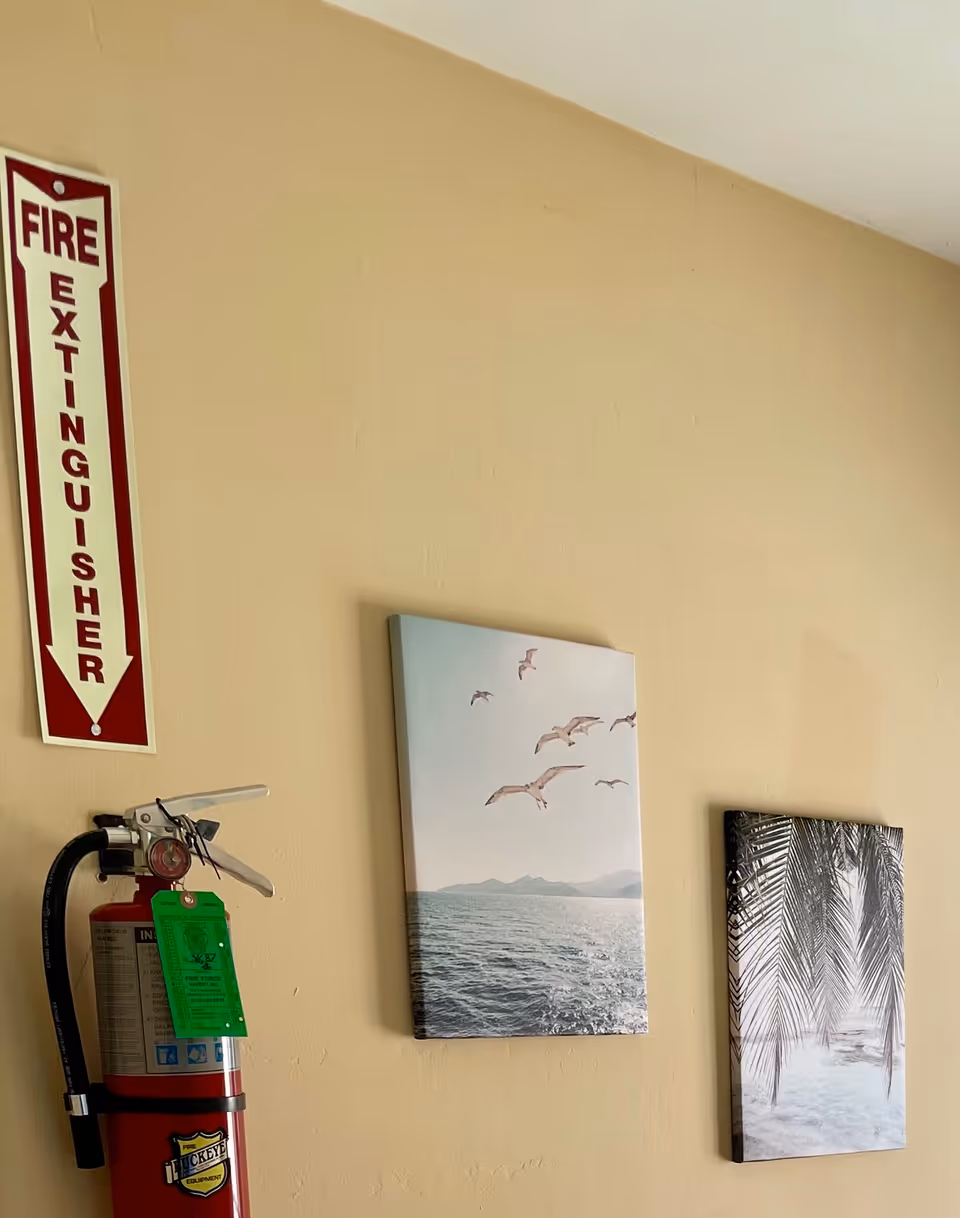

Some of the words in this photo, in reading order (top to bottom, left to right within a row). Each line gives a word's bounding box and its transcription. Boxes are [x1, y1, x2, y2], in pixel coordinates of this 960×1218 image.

[21, 200, 99, 266] FIRE
[50, 271, 105, 684] EXTINGUISHER
[186, 1174, 222, 1185] EQUIPMENT
